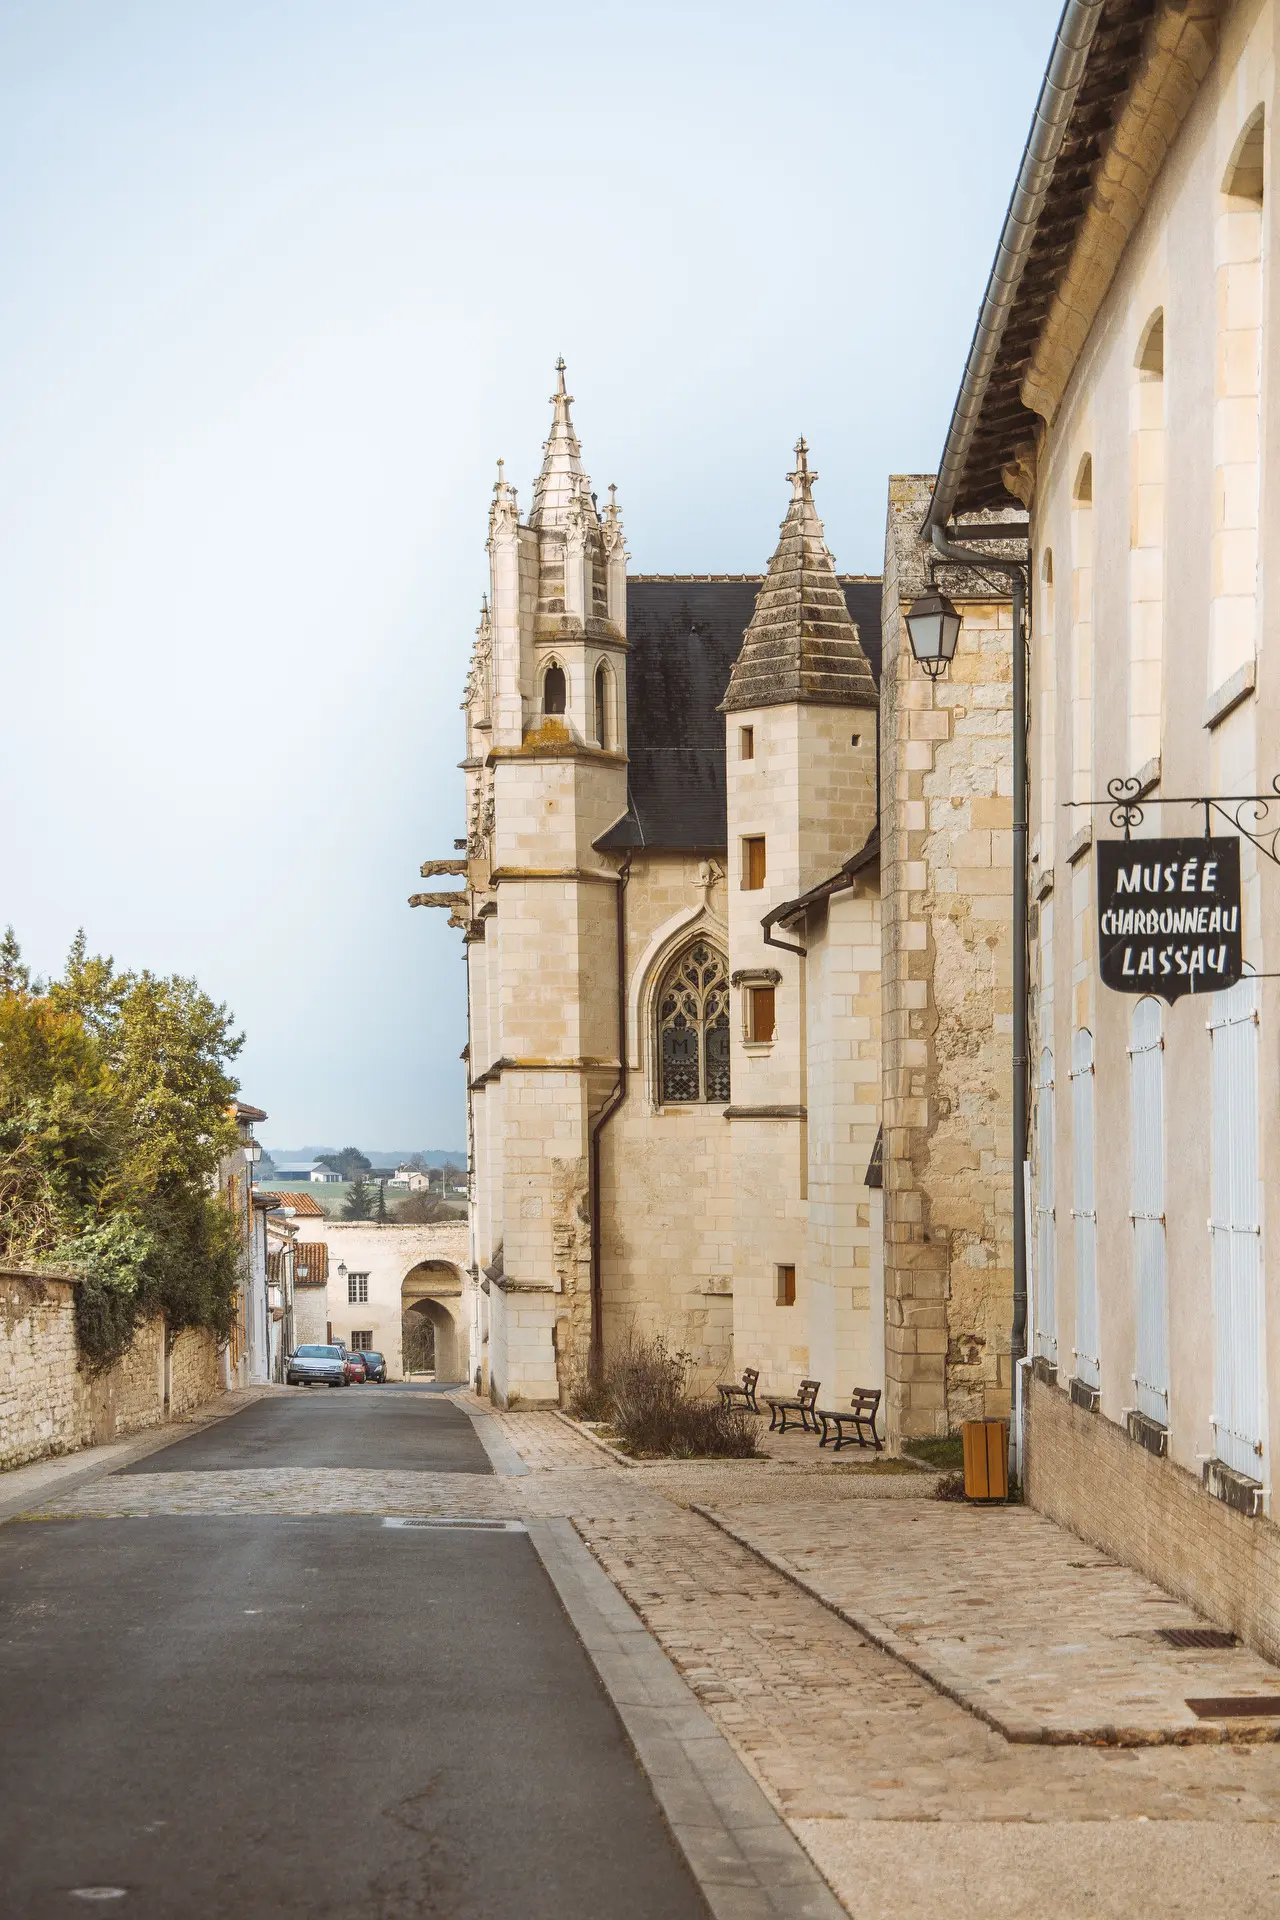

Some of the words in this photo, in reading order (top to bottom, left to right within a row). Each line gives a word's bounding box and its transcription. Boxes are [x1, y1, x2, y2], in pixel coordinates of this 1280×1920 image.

[1116, 858, 1218, 893] MUSÉE
[1101, 906, 1238, 935] CHARBONNEAU
[1122, 945, 1227, 975] LASSAY
[672, 1039, 688, 1054] M
